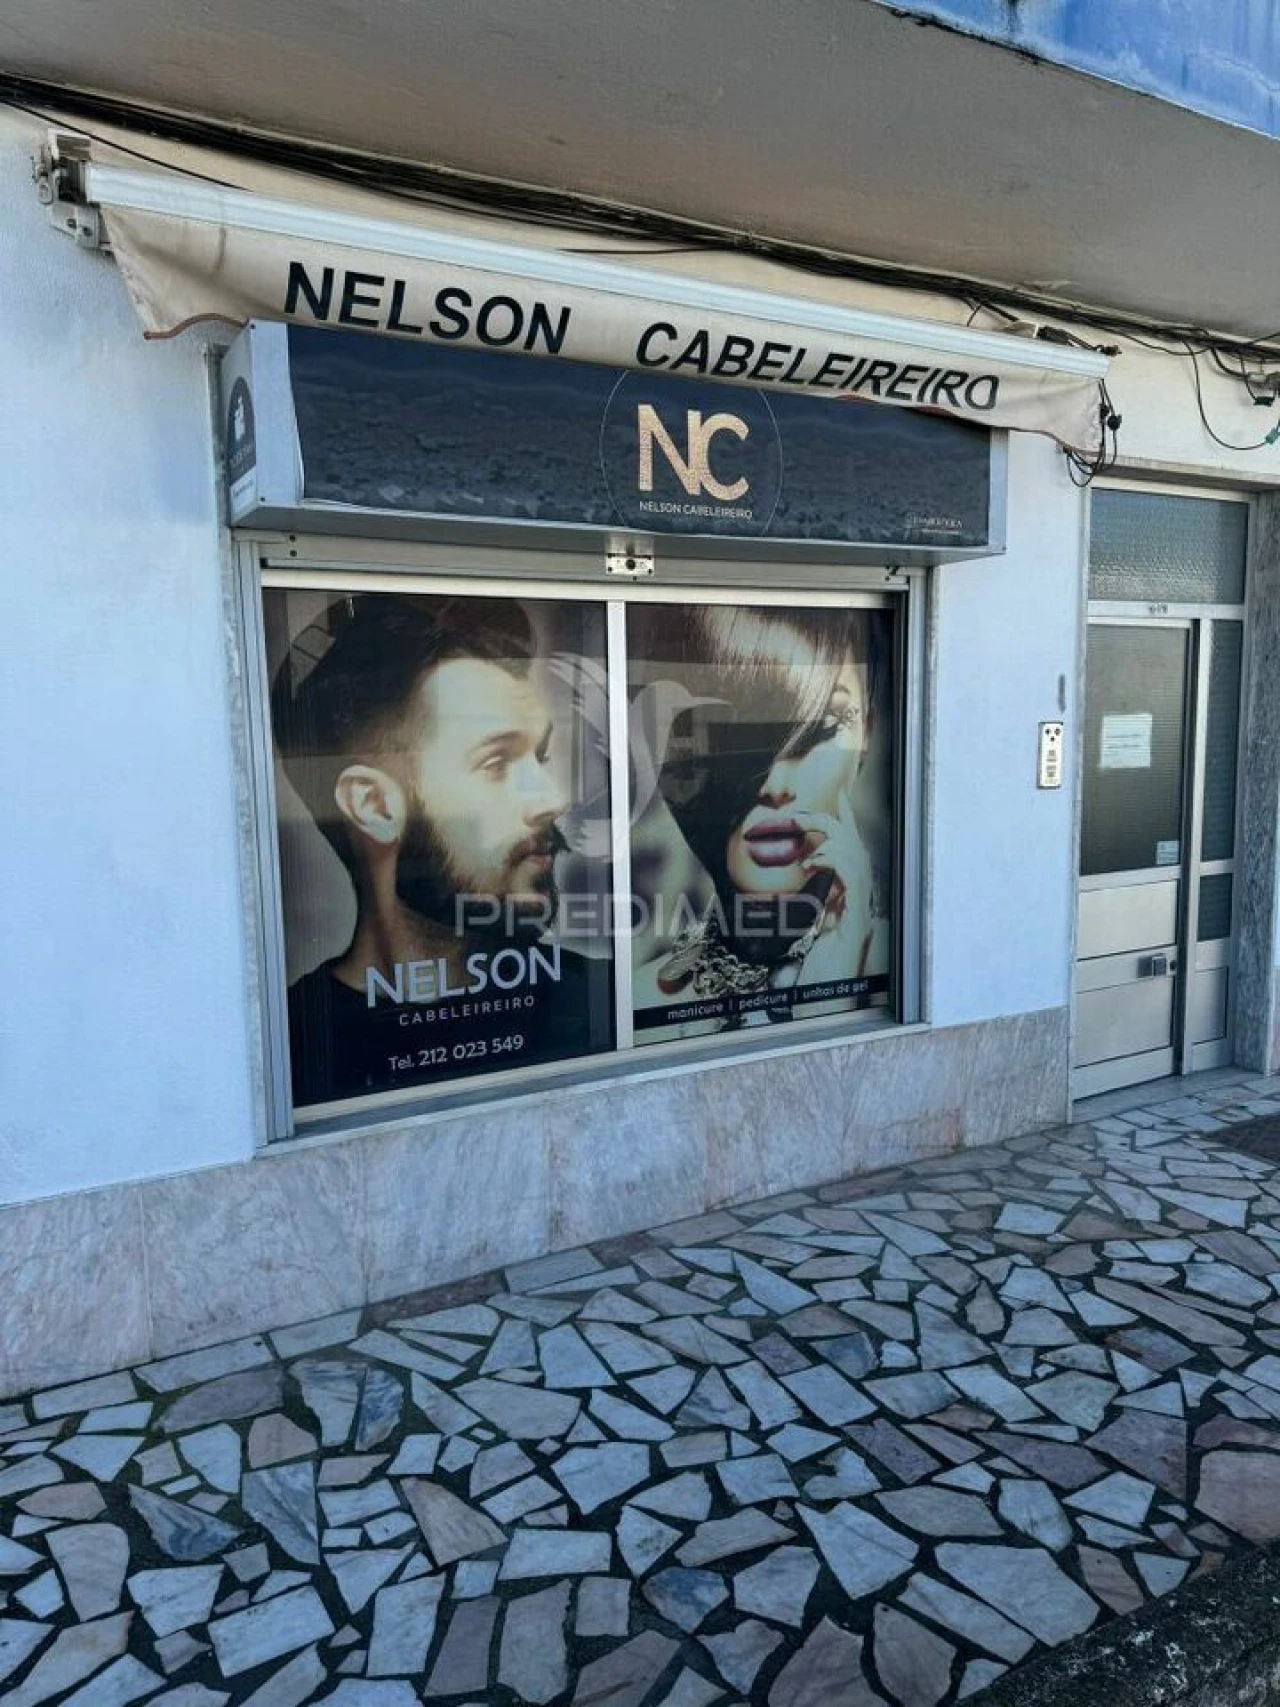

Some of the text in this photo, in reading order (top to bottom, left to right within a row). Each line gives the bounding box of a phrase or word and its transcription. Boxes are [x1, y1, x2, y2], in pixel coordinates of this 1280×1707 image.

[284, 261, 1000, 411] NELSON CABELEIREIRO
[637, 403, 750, 501] NC
[639, 500, 753, 520] NELSON CABELEIREIRO
[365, 940, 561, 1008] NELSON
[399, 995, 535, 1026] CABELEIREIRO
[668, 980, 869, 1020] manicure pedicure unhas de gel
[387, 1034, 524, 1071] Tel. 212 023 549
